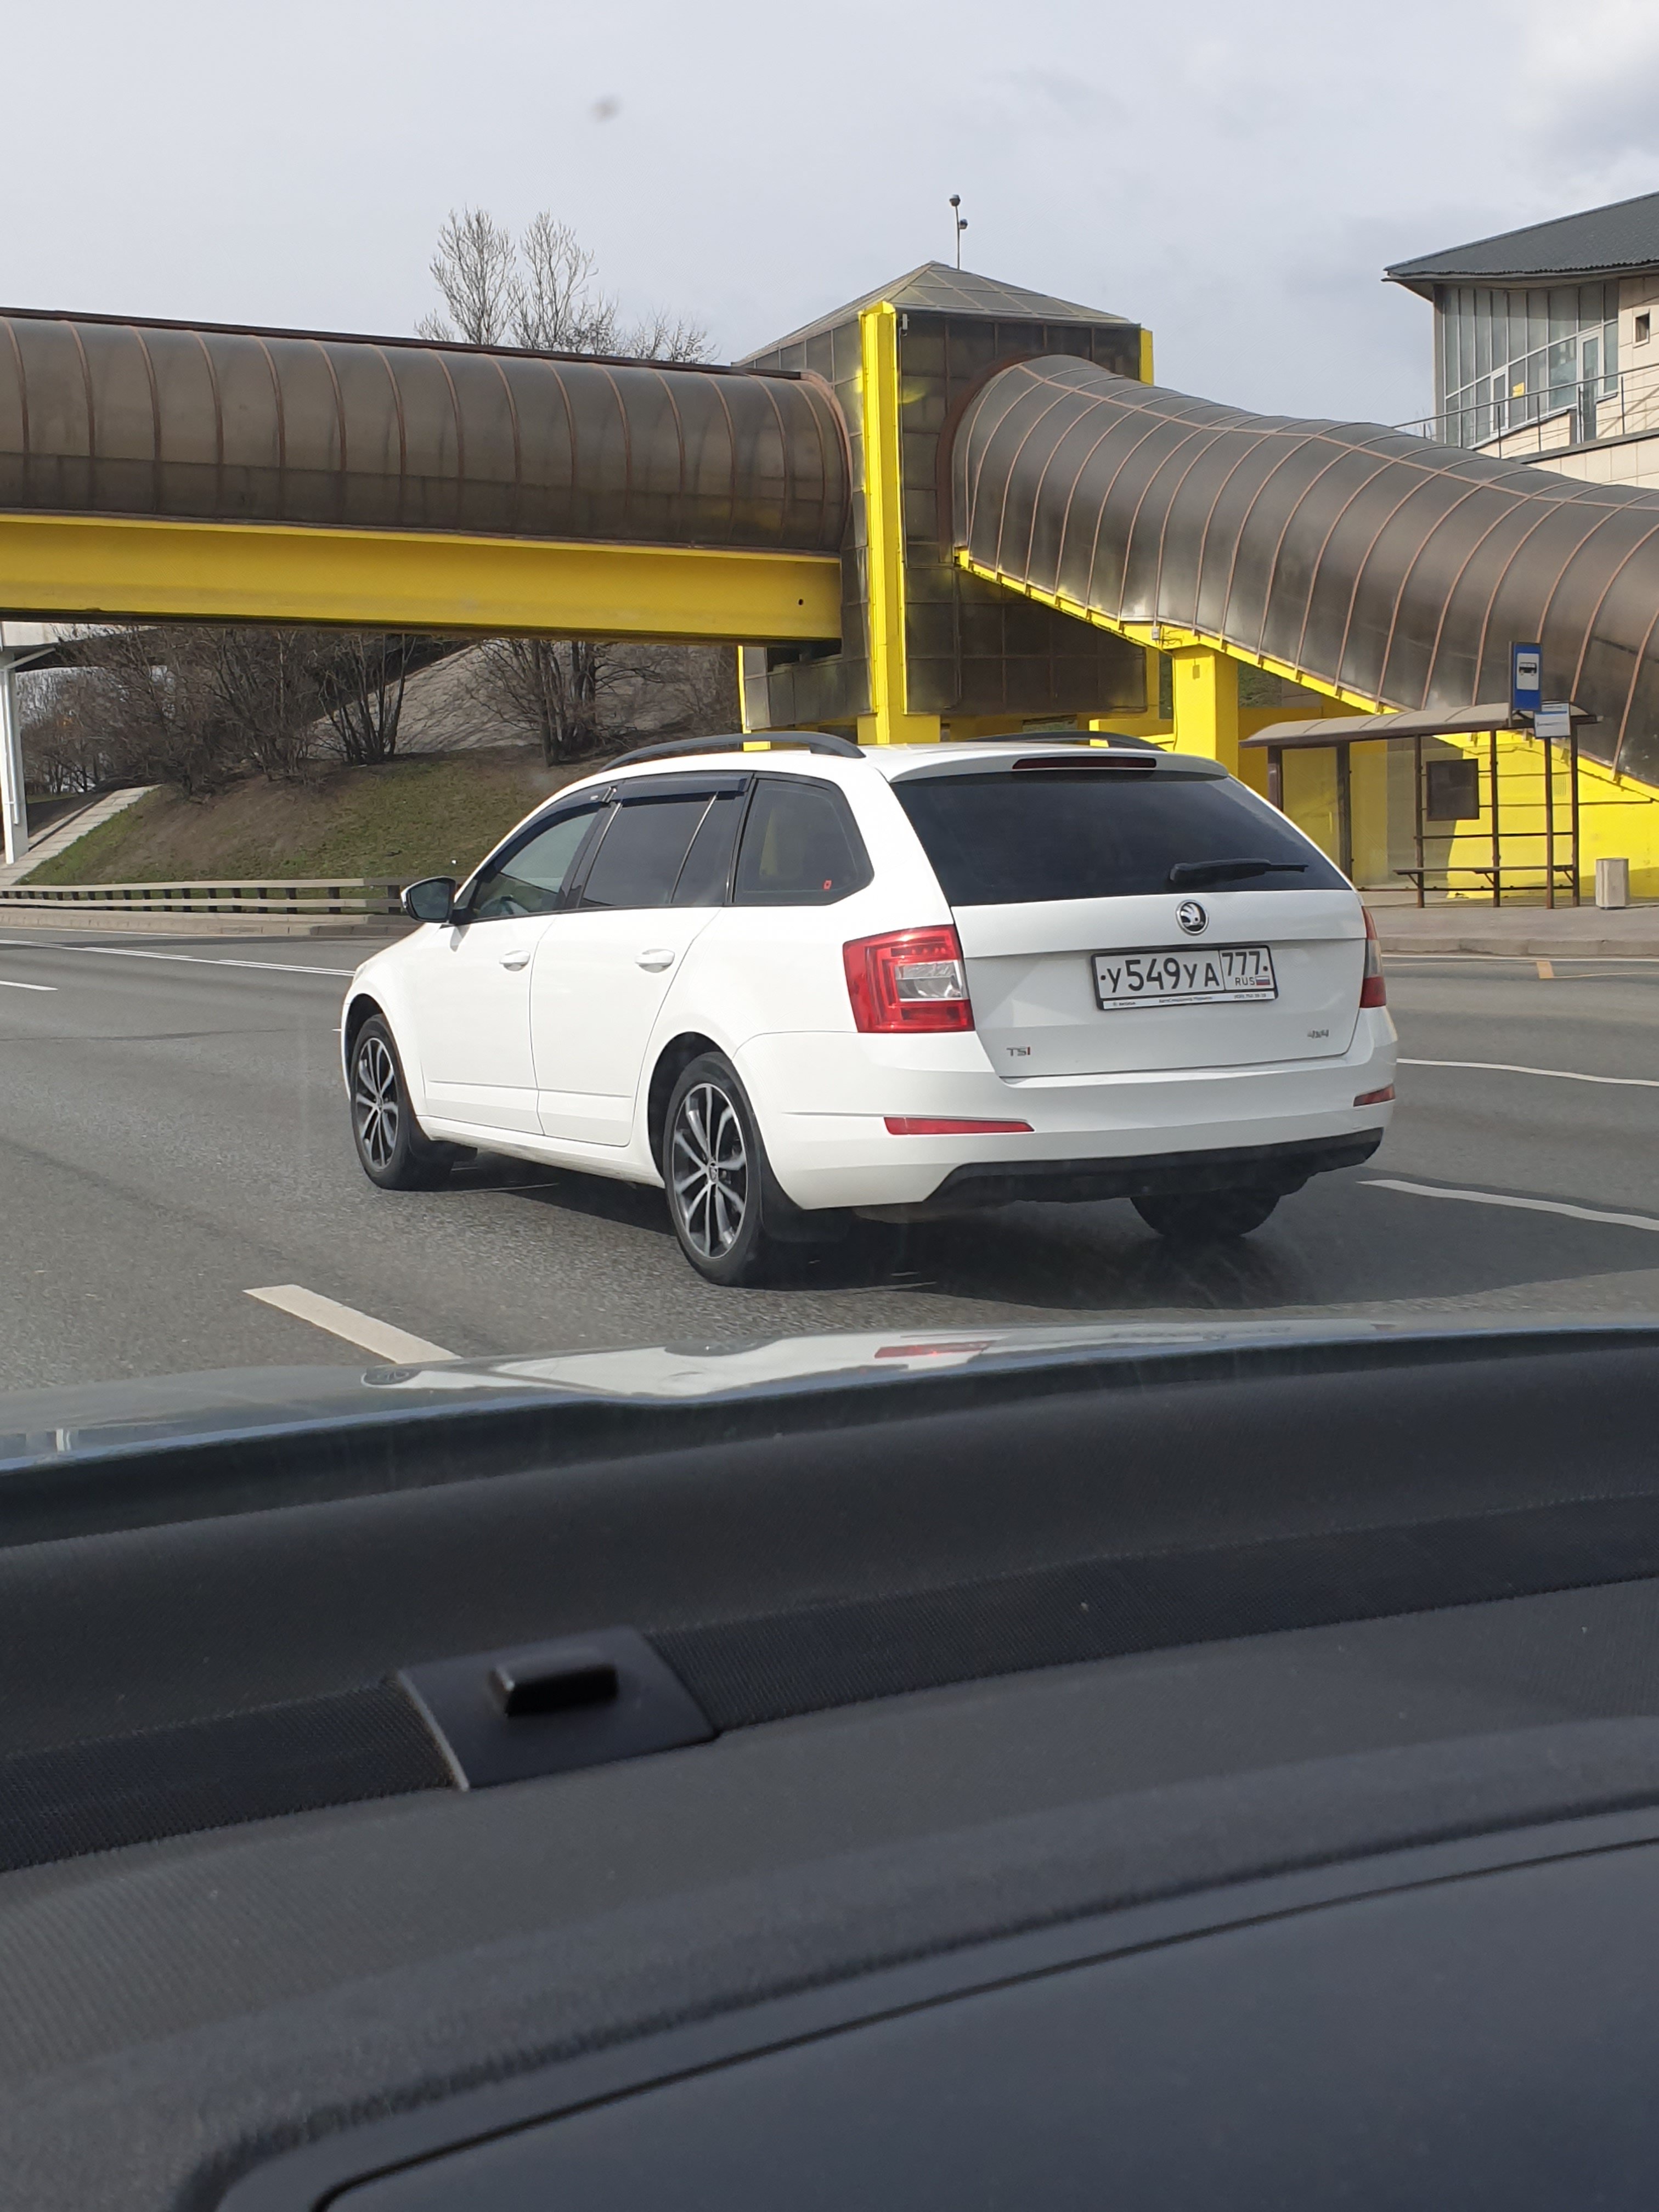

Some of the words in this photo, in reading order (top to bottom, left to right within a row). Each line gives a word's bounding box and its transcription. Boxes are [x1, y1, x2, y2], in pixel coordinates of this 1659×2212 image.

[1222, 951, 1260, 976] 777
[1235, 977, 1255, 986] RUS
[1006, 1046, 1030, 1057] TSI
